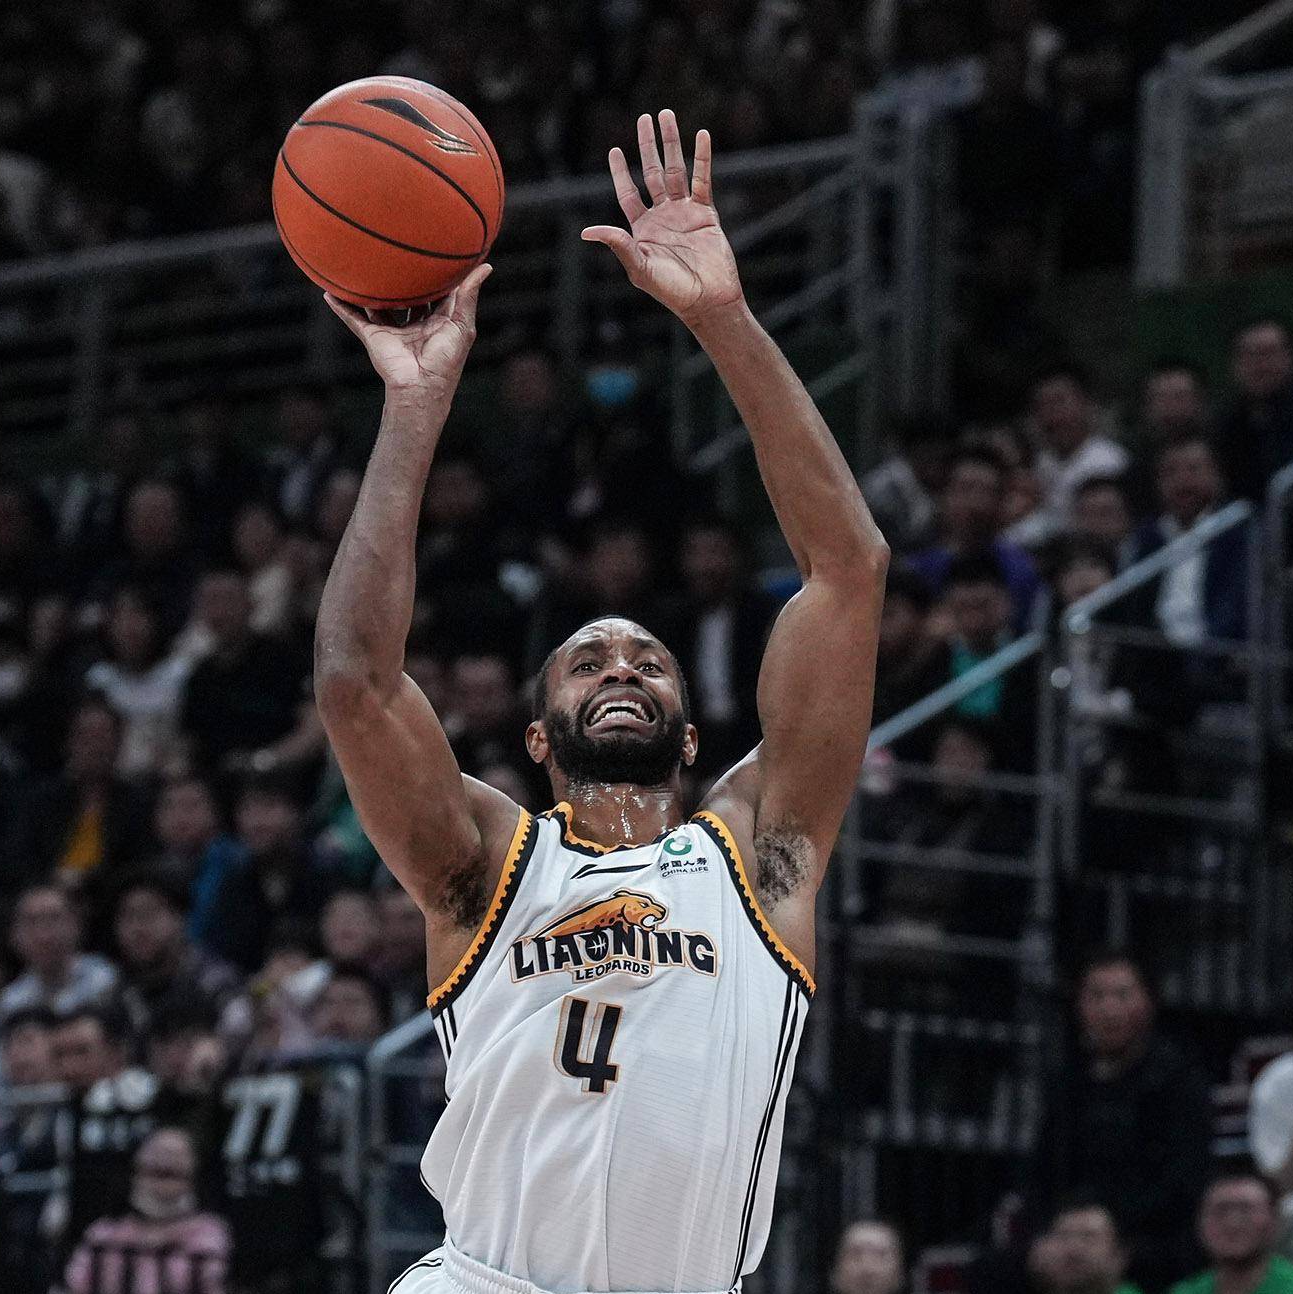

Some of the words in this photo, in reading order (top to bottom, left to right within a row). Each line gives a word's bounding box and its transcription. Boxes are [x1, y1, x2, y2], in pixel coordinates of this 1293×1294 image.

[660, 857, 707, 871] 中国人寿
[661, 868, 688, 878] CHINA
[509, 924, 718, 984] LIAONING
[574, 959, 651, 981] LEOPARDS
[553, 995, 624, 1094] 4
